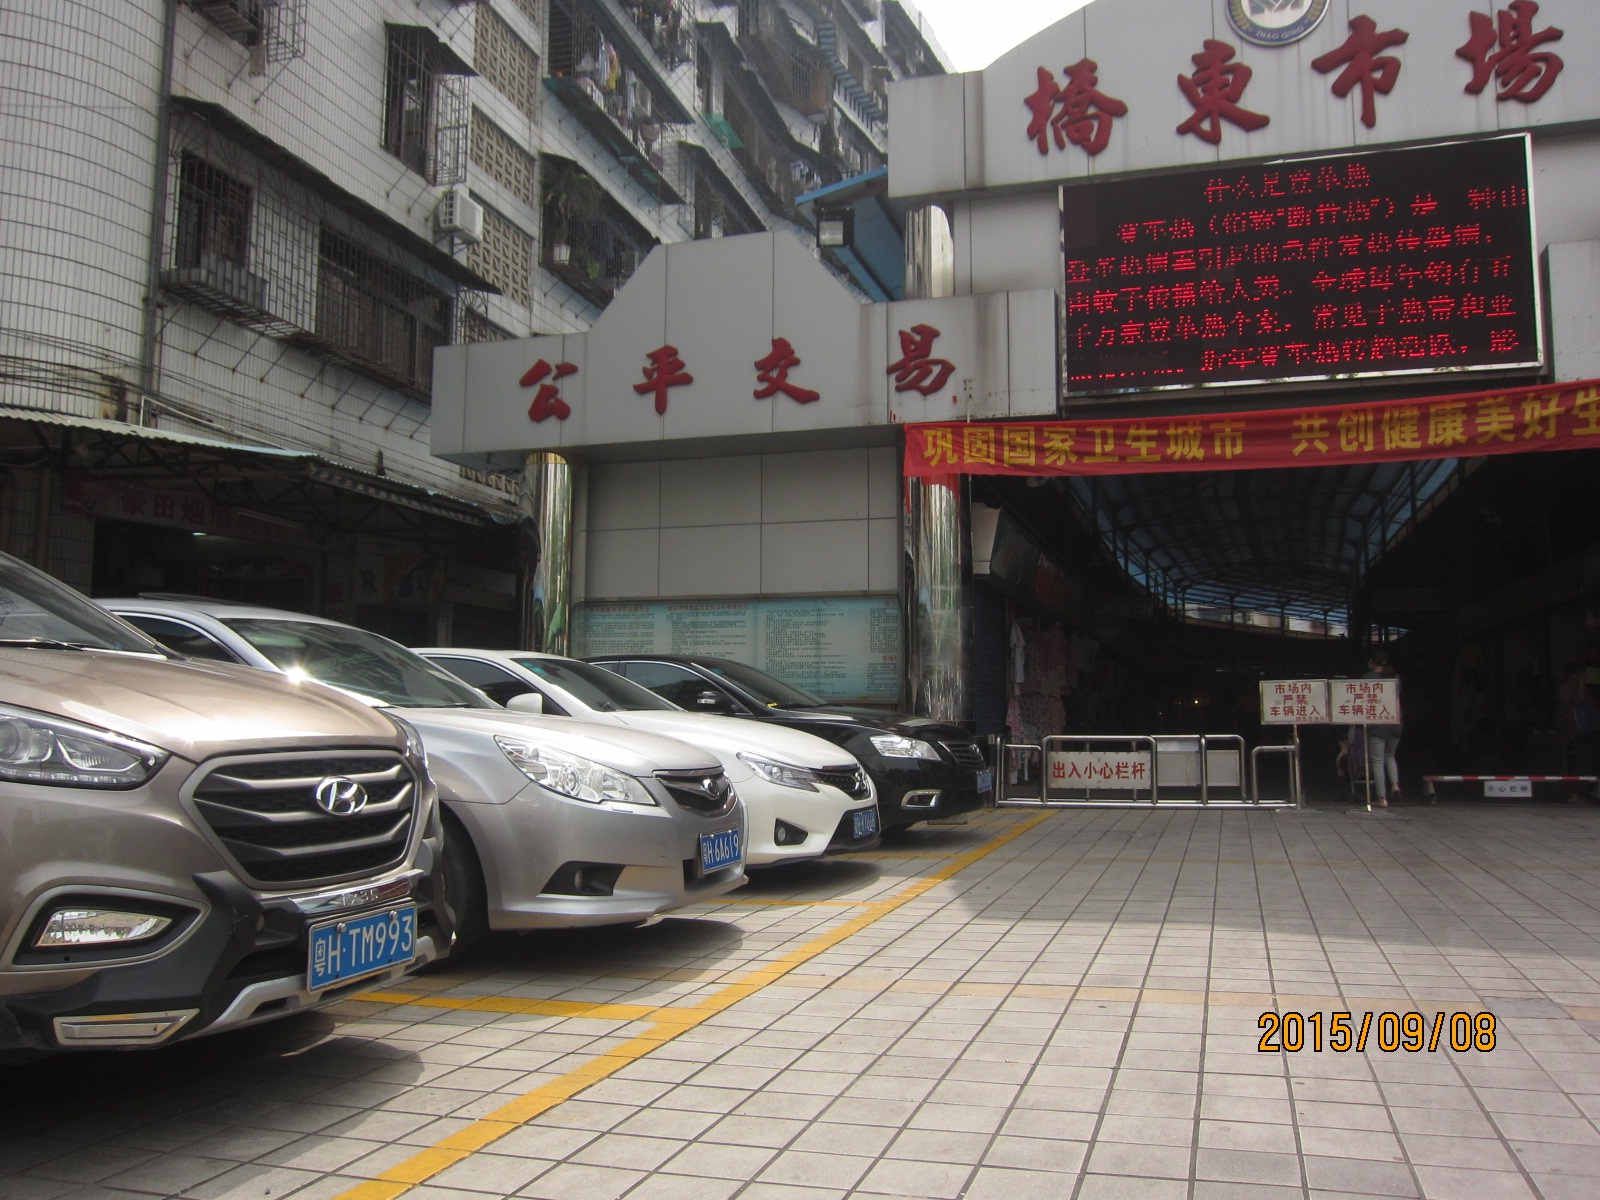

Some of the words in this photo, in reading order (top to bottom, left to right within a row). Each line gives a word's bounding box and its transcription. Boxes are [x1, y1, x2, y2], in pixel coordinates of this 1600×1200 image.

[1023, 1, 1564, 156] 橋東市場
[519, 323, 956, 423] 公平交易
[1292, 387, 1600, 456] 共创健康美好生
[922, 420, 1247, 466] 巩固国家卫生城市
[1274, 683, 1312, 694] 市场内
[1345, 683, 1384, 694] 市场内
[1283, 695, 1308, 705] 严禁
[1353, 693, 1378, 704] 严禁
[1270, 705, 1321, 717] 车辆进入
[1338, 704, 1390, 716] 车辆进入
[1052, 760, 1146, 780] 出入小心栏杆
